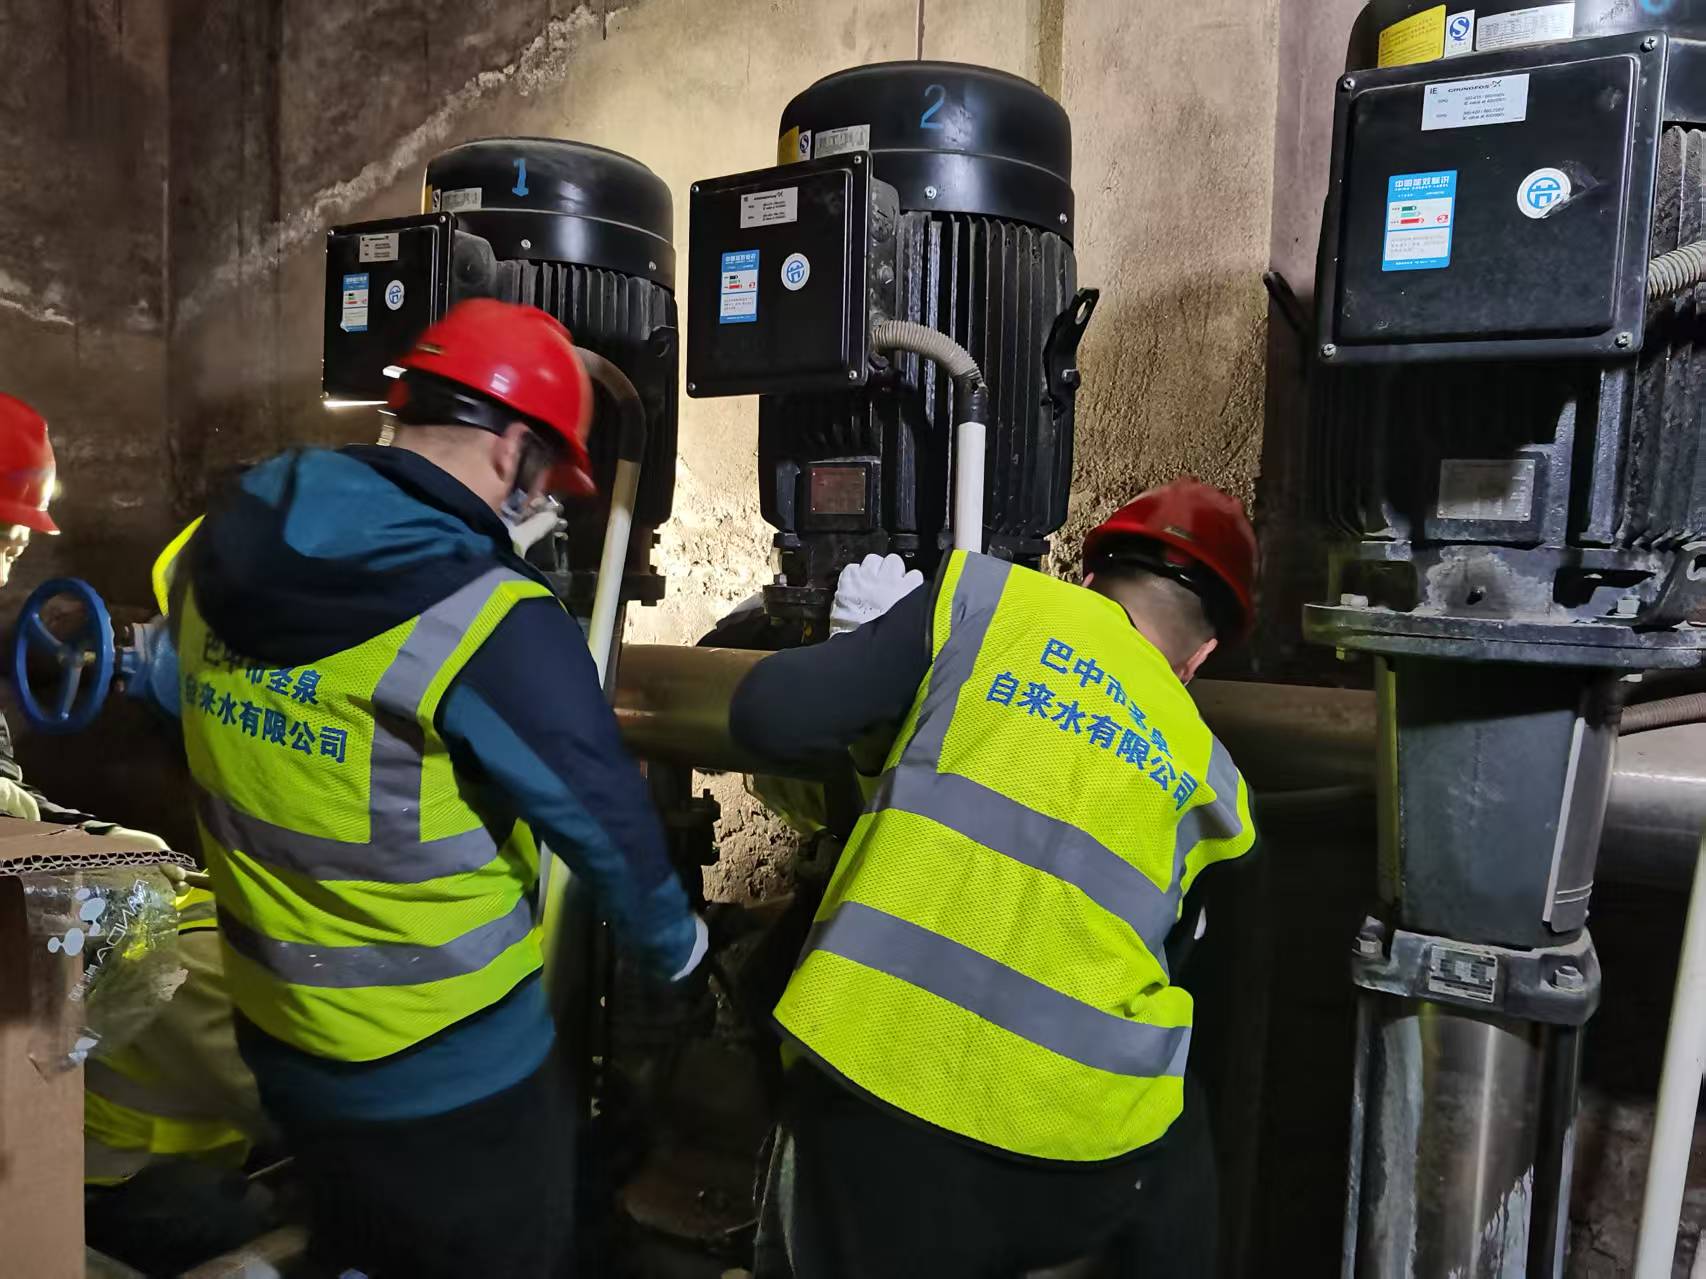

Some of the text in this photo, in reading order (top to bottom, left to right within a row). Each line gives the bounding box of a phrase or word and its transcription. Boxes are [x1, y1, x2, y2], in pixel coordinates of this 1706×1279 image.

[919, 83, 947, 130] 2
[511, 157, 529, 198] 1
[184, 672, 348, 764] 自来水有限公司
[986, 671, 1199, 811] 自来水有限公司
